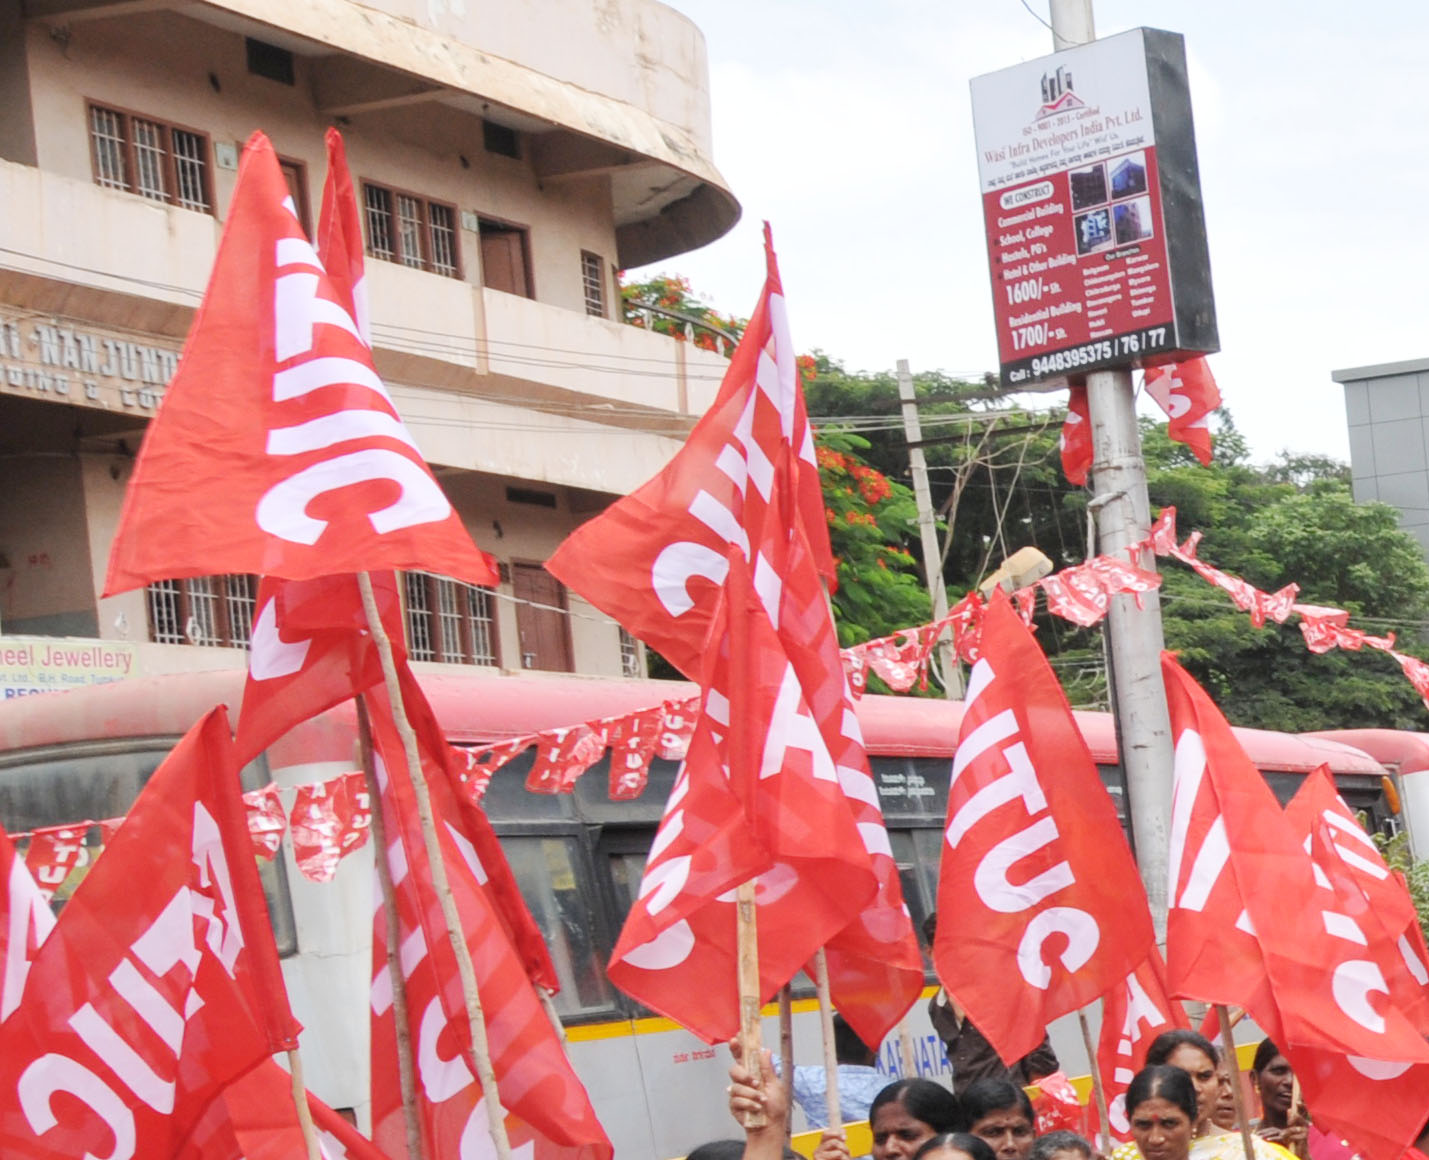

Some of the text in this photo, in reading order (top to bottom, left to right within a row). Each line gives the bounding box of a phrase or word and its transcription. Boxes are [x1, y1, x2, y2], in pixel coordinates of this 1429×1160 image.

[1008, 142, 1030, 158] Infra
[1032, 128, 1078, 150] Developers
[1080, 119, 1103, 136] India
[1124, 106, 1143, 124] Ltd.
[1006, 276, 1048, 305] 1600/-
[1011, 322, 1054, 350] 1700/-
[1031, 340, 1112, 376] 9448395375
[1120, 334, 1140, 354] 76
[1148, 327, 1166, 347] 77
[41, 645, 133, 675] Jewellery
